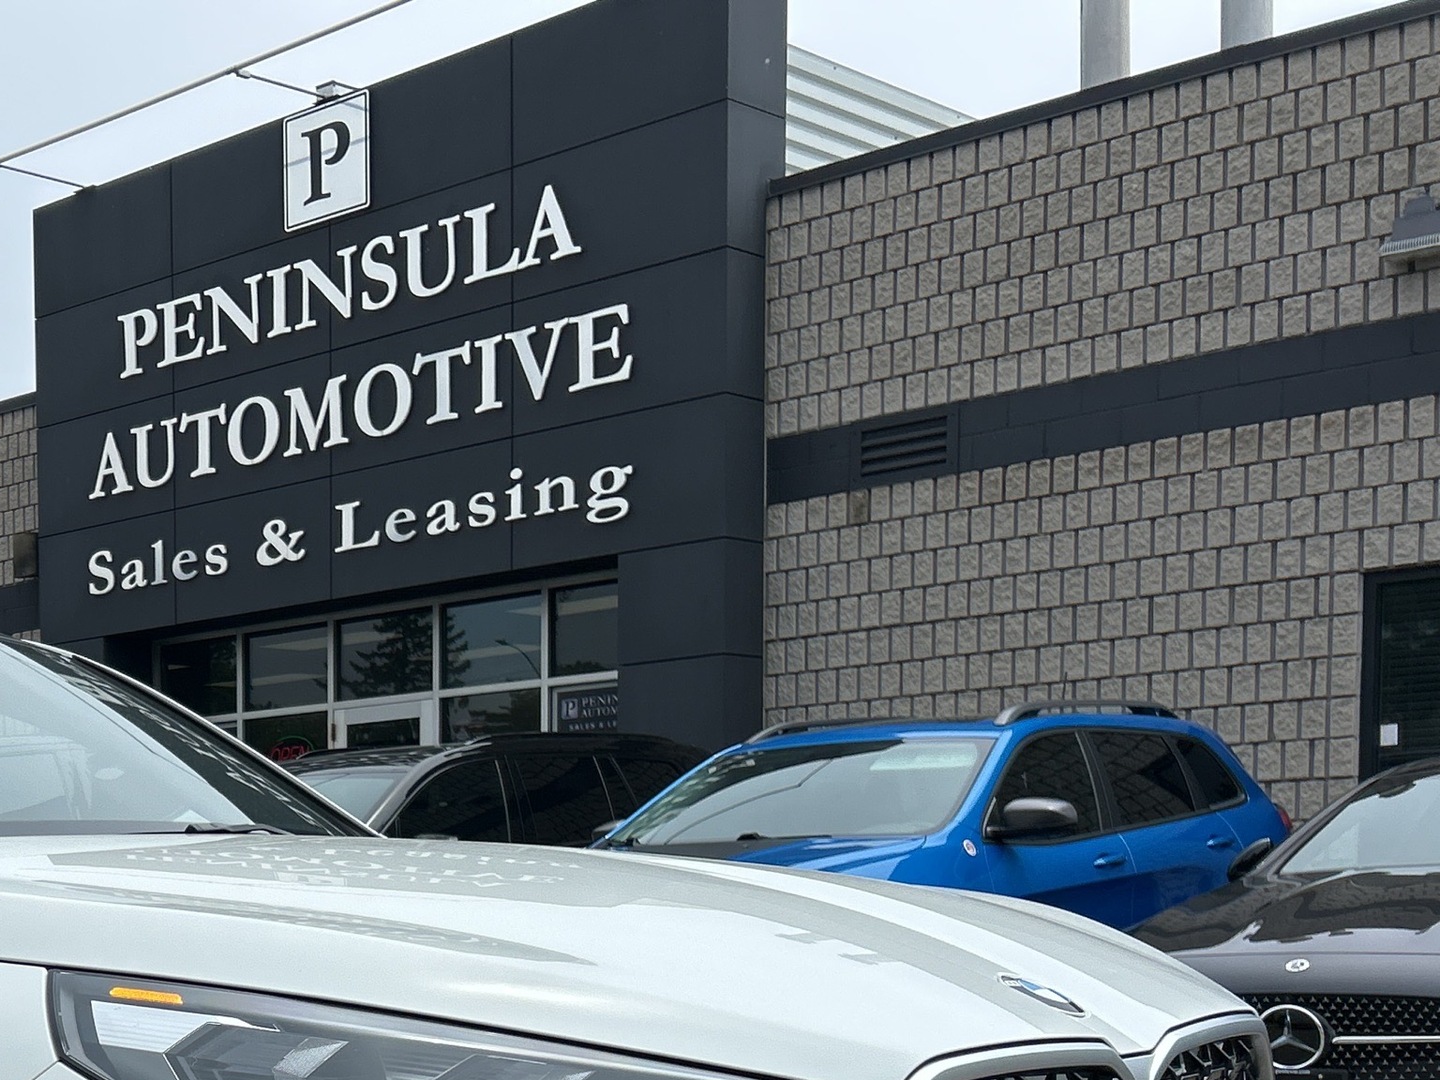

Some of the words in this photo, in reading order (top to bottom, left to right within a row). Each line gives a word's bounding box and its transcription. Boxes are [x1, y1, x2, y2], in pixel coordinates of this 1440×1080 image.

[300, 118, 351, 207] P
[117, 184, 582, 380] PENINSULA
[88, 303, 634, 500] AUTOMOTIVE
[88, 540, 229, 597] Sales
[256, 519, 306, 567] &
[335, 464, 634, 554] Leasing
[581, 694, 618, 708] PENIN
[581, 705, 617, 718] AUTOM
